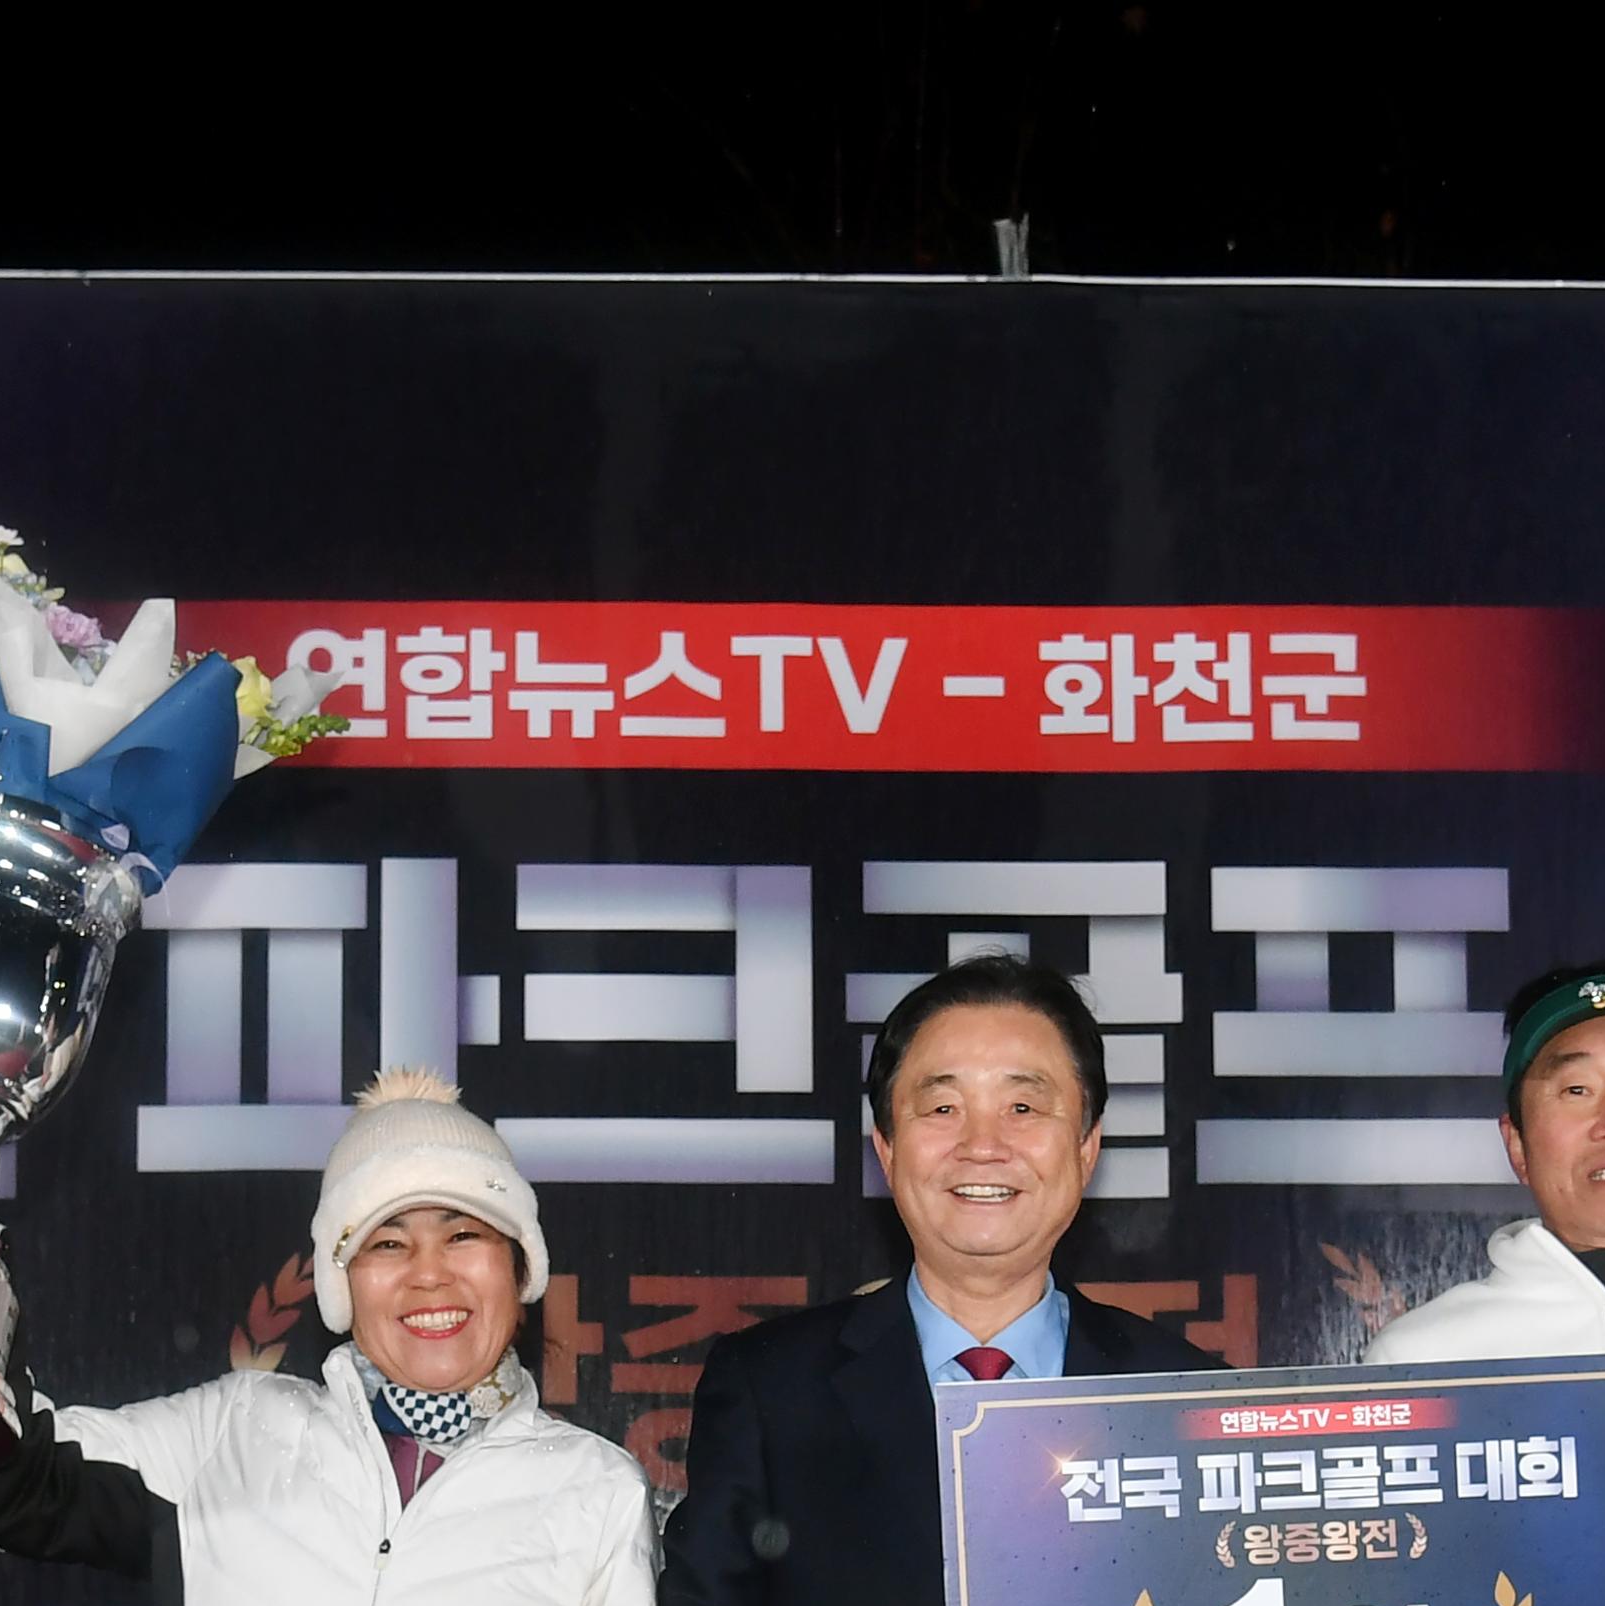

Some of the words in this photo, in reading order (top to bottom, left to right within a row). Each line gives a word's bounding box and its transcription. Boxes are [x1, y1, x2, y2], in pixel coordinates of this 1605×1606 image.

[283, 627, 908, 741] 연합뉴스TV
[1037, 629, 1367, 743] 화천군
[1220, 1408, 1330, 1434] 연합뉴스TV
[1352, 1403, 1412, 1428] 화천군
[1060, 1455, 1182, 1522] 전국
[1197, 1444, 1444, 1514] 파크골프
[1455, 1435, 1579, 1501] 대회
[1242, 1519, 1398, 1567] 왕중왕전
